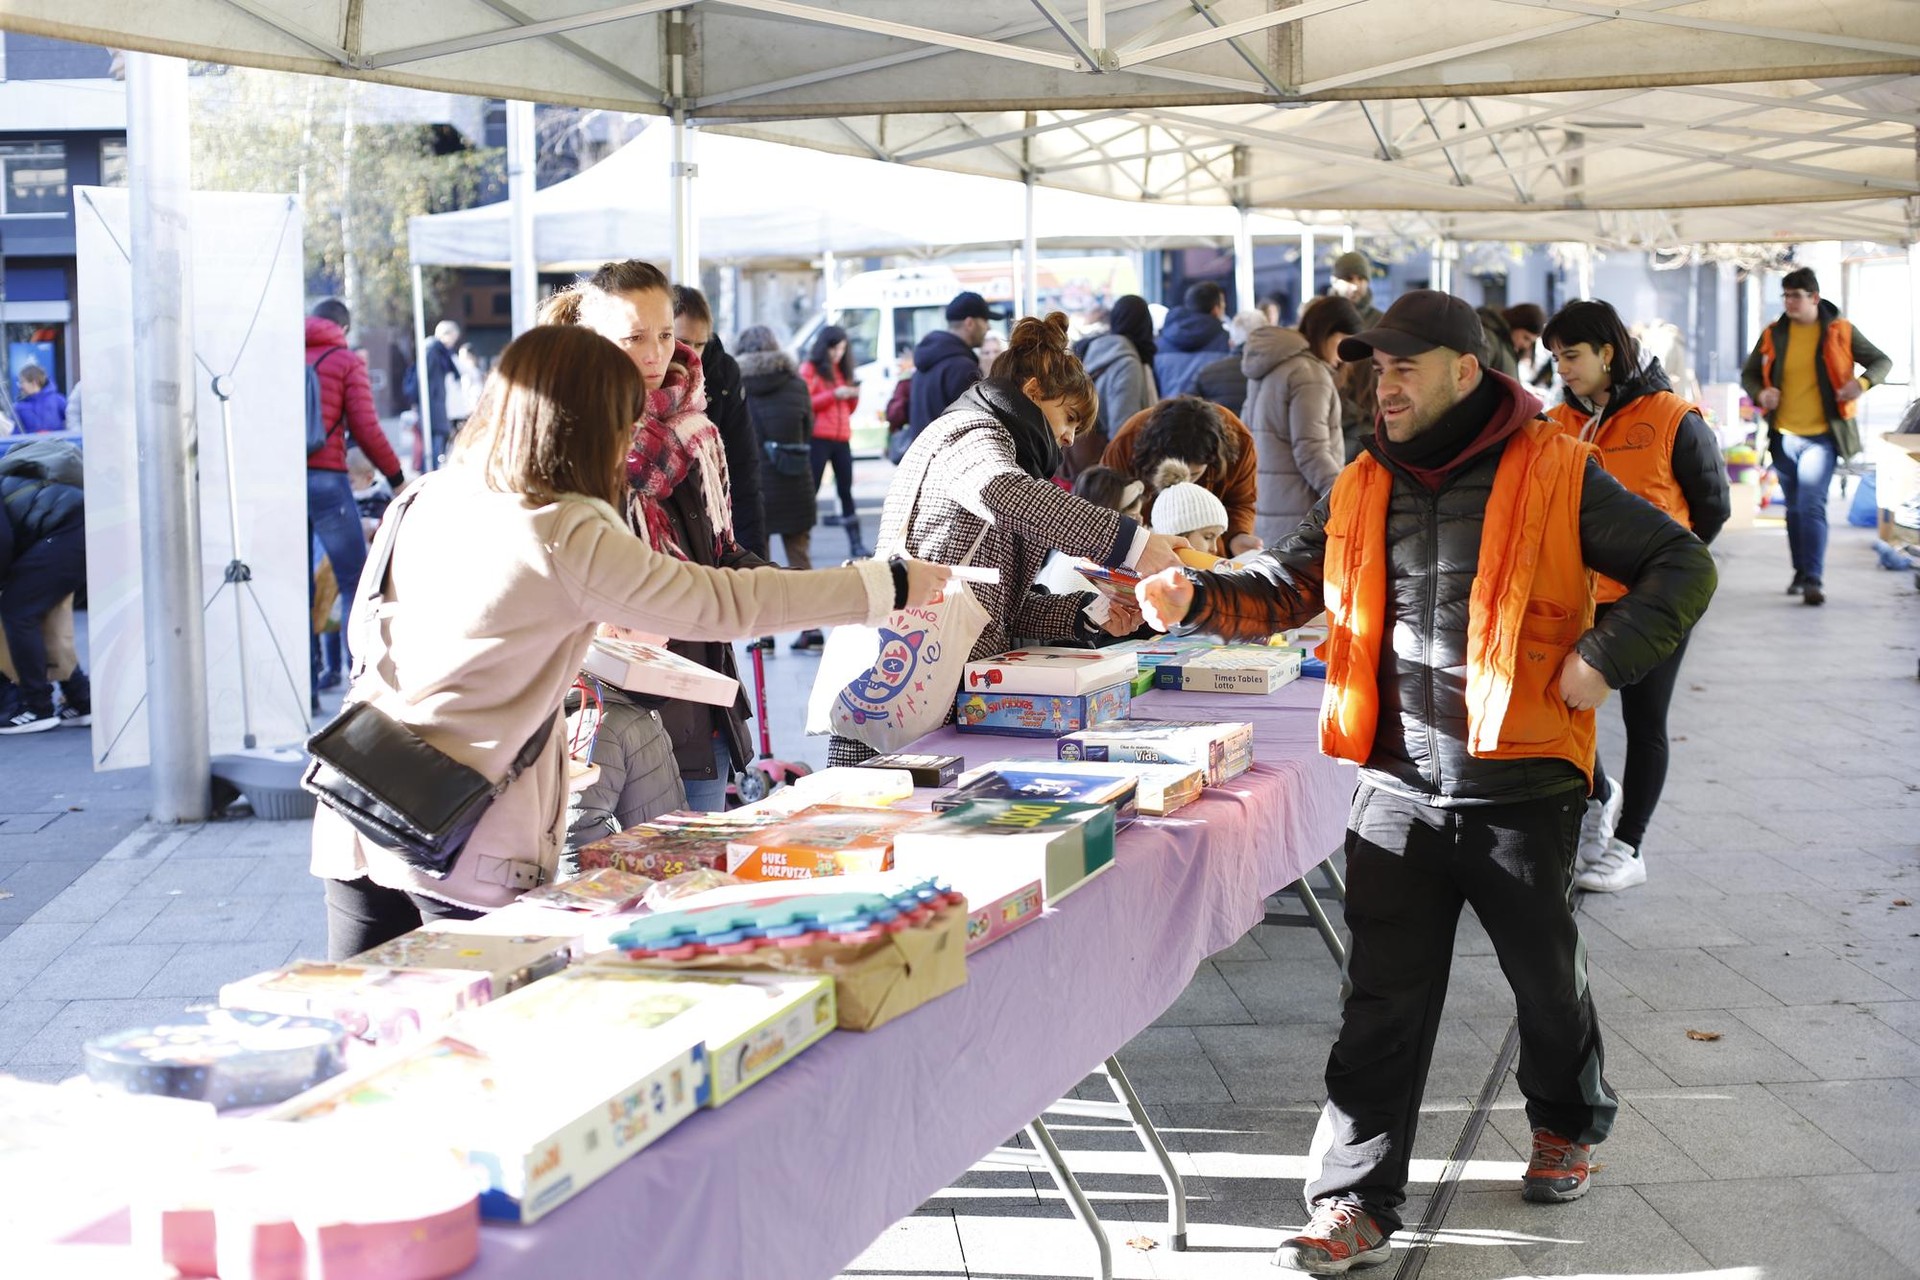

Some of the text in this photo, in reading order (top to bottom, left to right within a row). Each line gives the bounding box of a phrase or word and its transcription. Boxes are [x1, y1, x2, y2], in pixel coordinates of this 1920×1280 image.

[1214, 674, 1263, 683] Times Tables
[1214, 682, 1234, 690] Lotto
[1134, 750, 1159, 762] Vida
[761, 864, 813, 879] GORPUTZA
